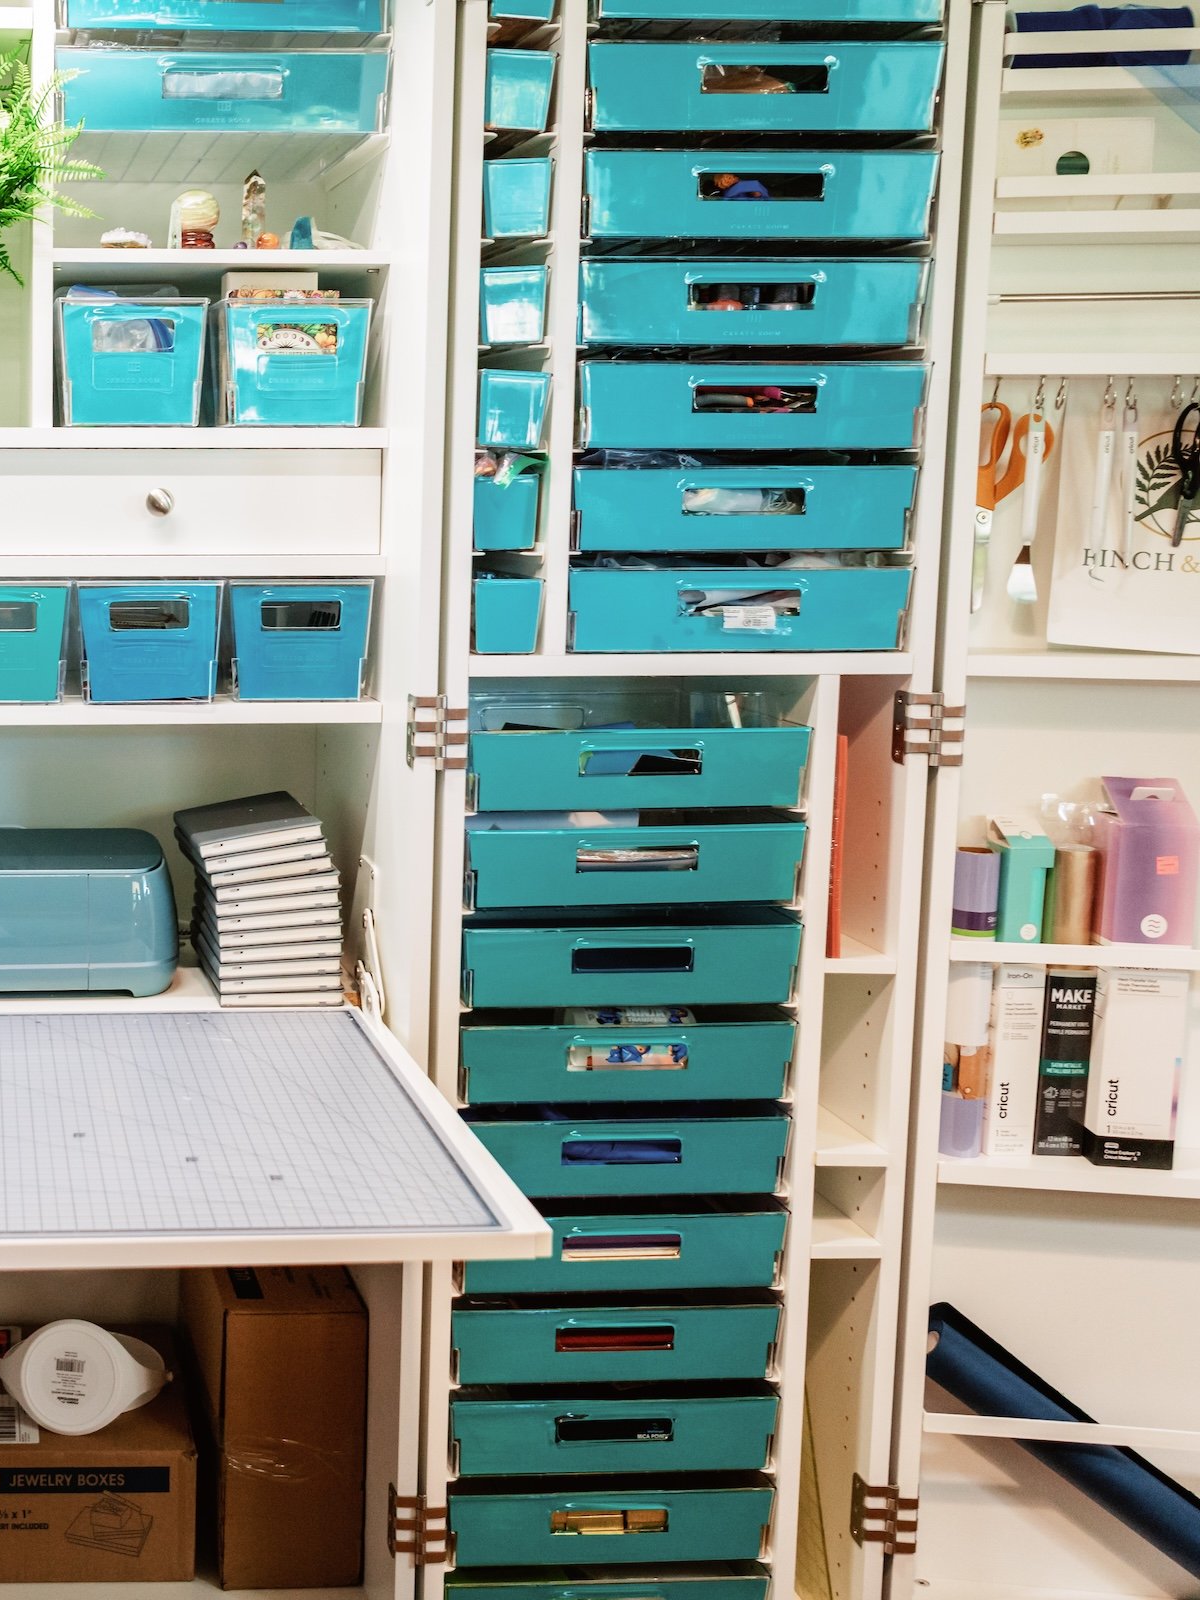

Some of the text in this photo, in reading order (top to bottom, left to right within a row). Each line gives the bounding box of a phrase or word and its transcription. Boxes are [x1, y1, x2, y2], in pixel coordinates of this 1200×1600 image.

[1050, 987, 1093, 1004] MAKE
[997, 1082, 1010, 1119] cricut
[1105, 1079, 1119, 1116] cricut
[9, 1473, 73, 1487] JEWELRY
[77, 1473, 125, 1487] BOXES
[11, 1522, 49, 1530] INCLUDED
